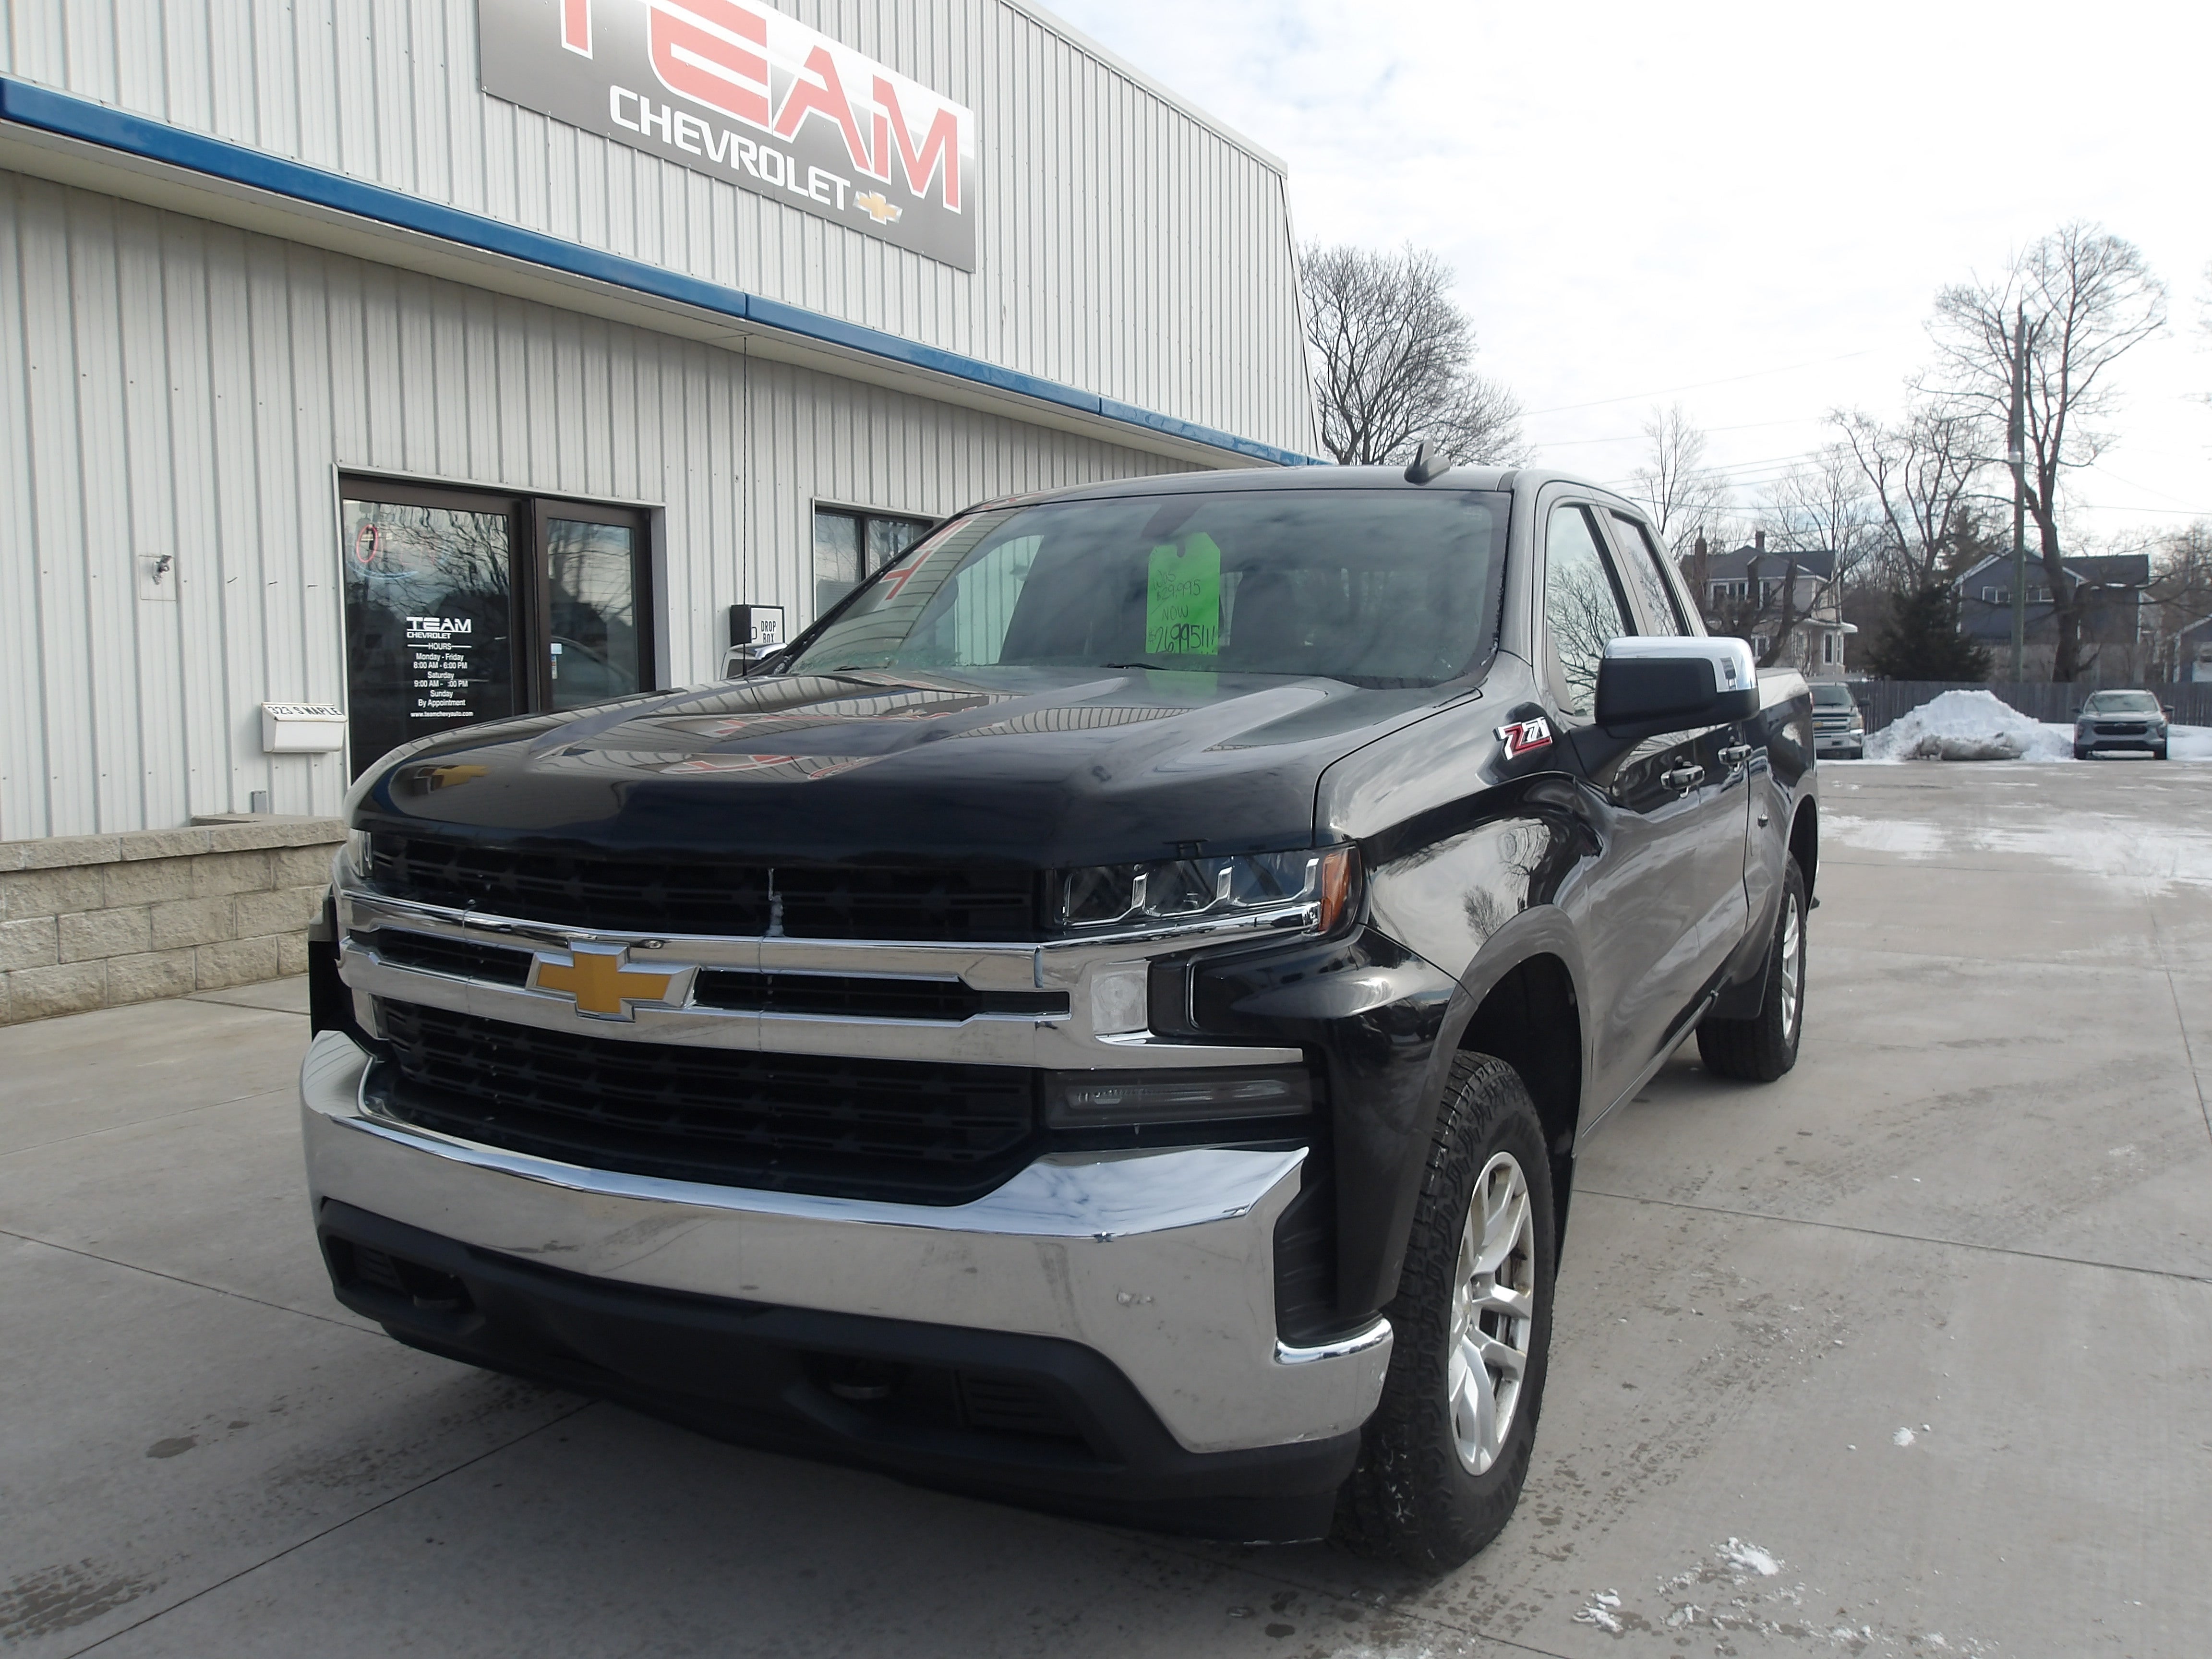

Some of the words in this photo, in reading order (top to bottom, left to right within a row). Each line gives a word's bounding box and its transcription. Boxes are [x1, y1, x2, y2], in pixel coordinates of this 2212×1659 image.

[610, 84, 851, 211] CHEVROLET
[1162, 604, 1189, 621] NOW
[407, 616, 472, 632] TEAM
[761, 621, 776, 632] DROP
[763, 633, 774, 643] BOX
[428, 642, 452, 650] HOURS
[415, 652, 441, 662] Monday
[445, 653, 464, 662] Friday
[427, 671, 455, 680] Saturday
[430, 690, 454, 698] Sunday
[418, 699, 427, 708] By
[427, 699, 466, 708] Appointment
[268, 706, 293, 715] 323
[293, 707, 304, 715] S
[301, 707, 343, 716] MAPLE
[1492, 716, 1553, 760] Z71
